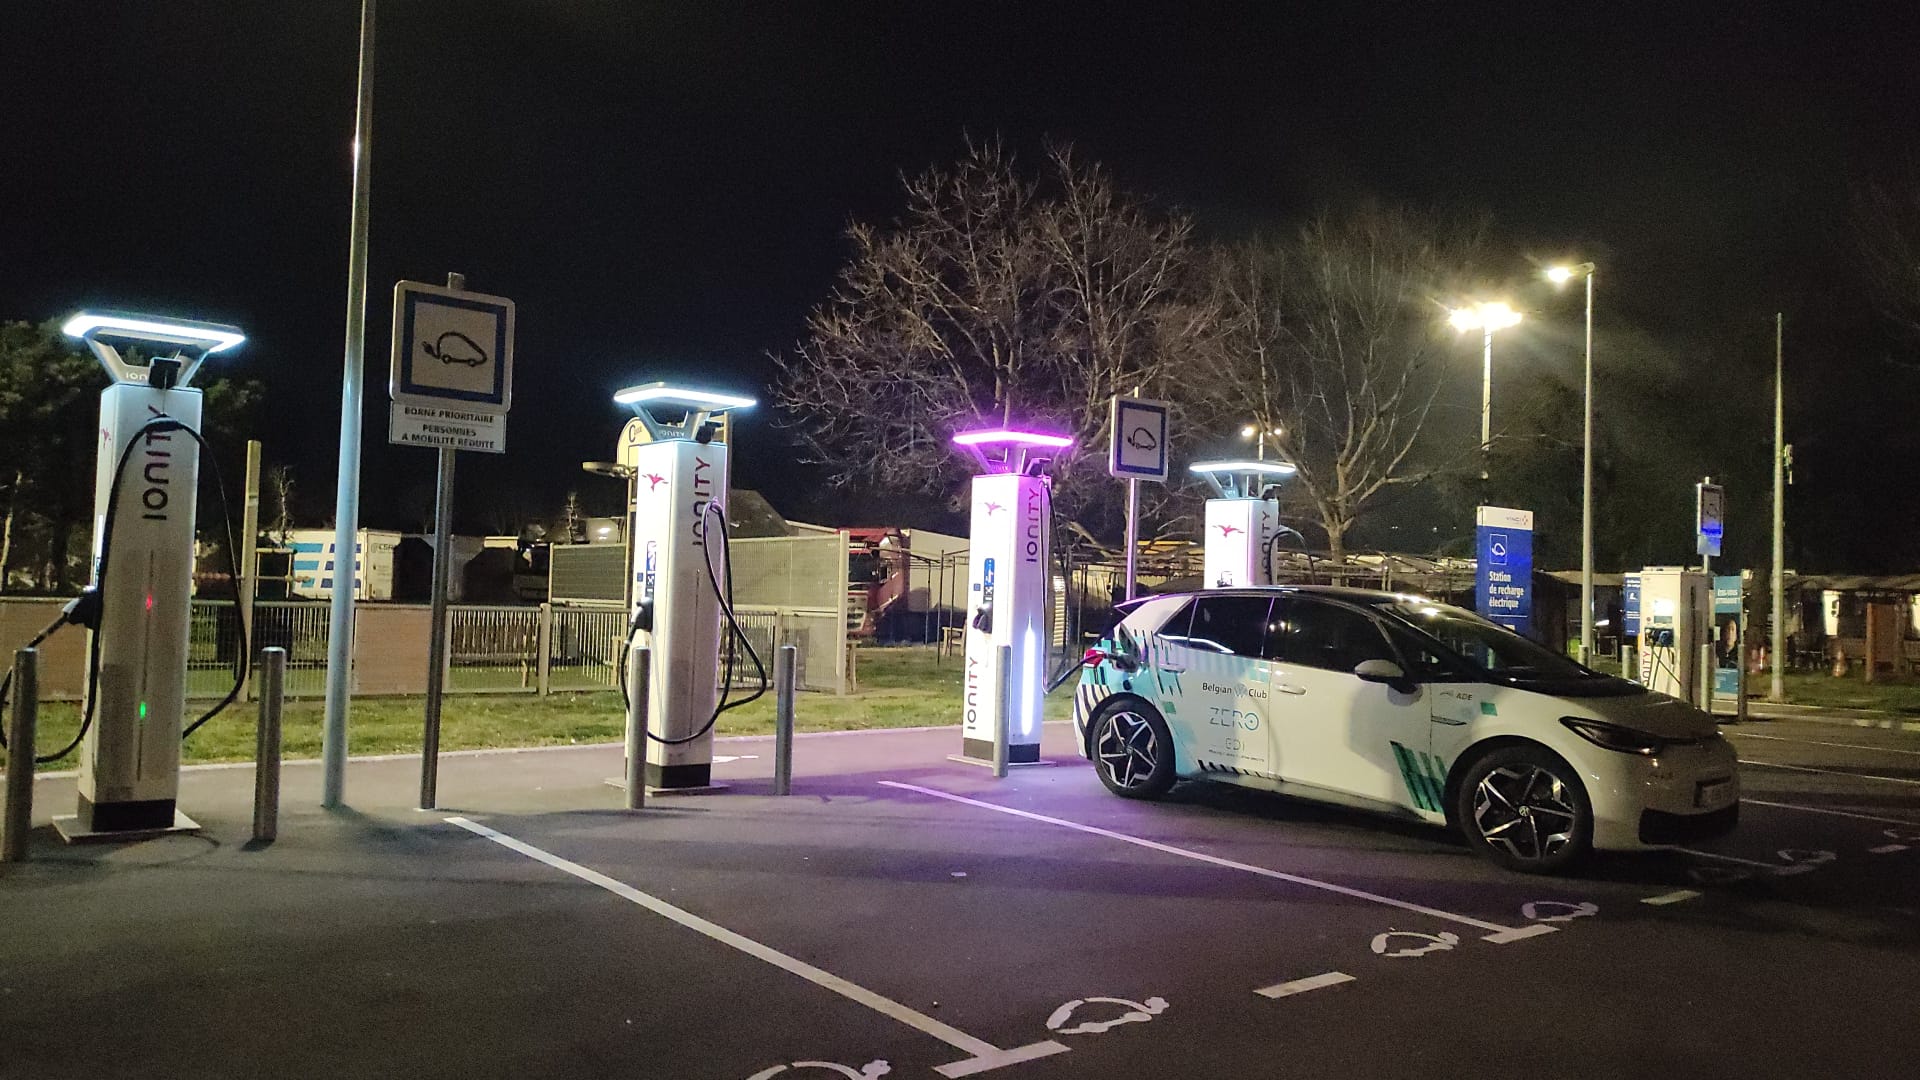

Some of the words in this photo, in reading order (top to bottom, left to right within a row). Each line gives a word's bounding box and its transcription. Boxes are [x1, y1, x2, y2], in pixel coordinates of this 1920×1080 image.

[126, 372, 149, 381] ION
[404, 407, 436, 417] BORNE
[438, 410, 495, 423] PRIORITAIRE
[422, 424, 477, 436] PERSONNES
[1026, 487, 1040, 563] IONITY
[1489, 571, 1511, 582] Station
[1489, 584, 1497, 593] de
[1498, 585, 1524, 598] recharge
[1489, 597, 1519, 610] électrique
[1642, 651, 1651, 688] ONITY
[967, 657, 978, 730] IONITY
[1202, 683, 1232, 695] Belgian
[1248, 688, 1267, 699] Club
[1209, 706, 1259, 731] ZERO
